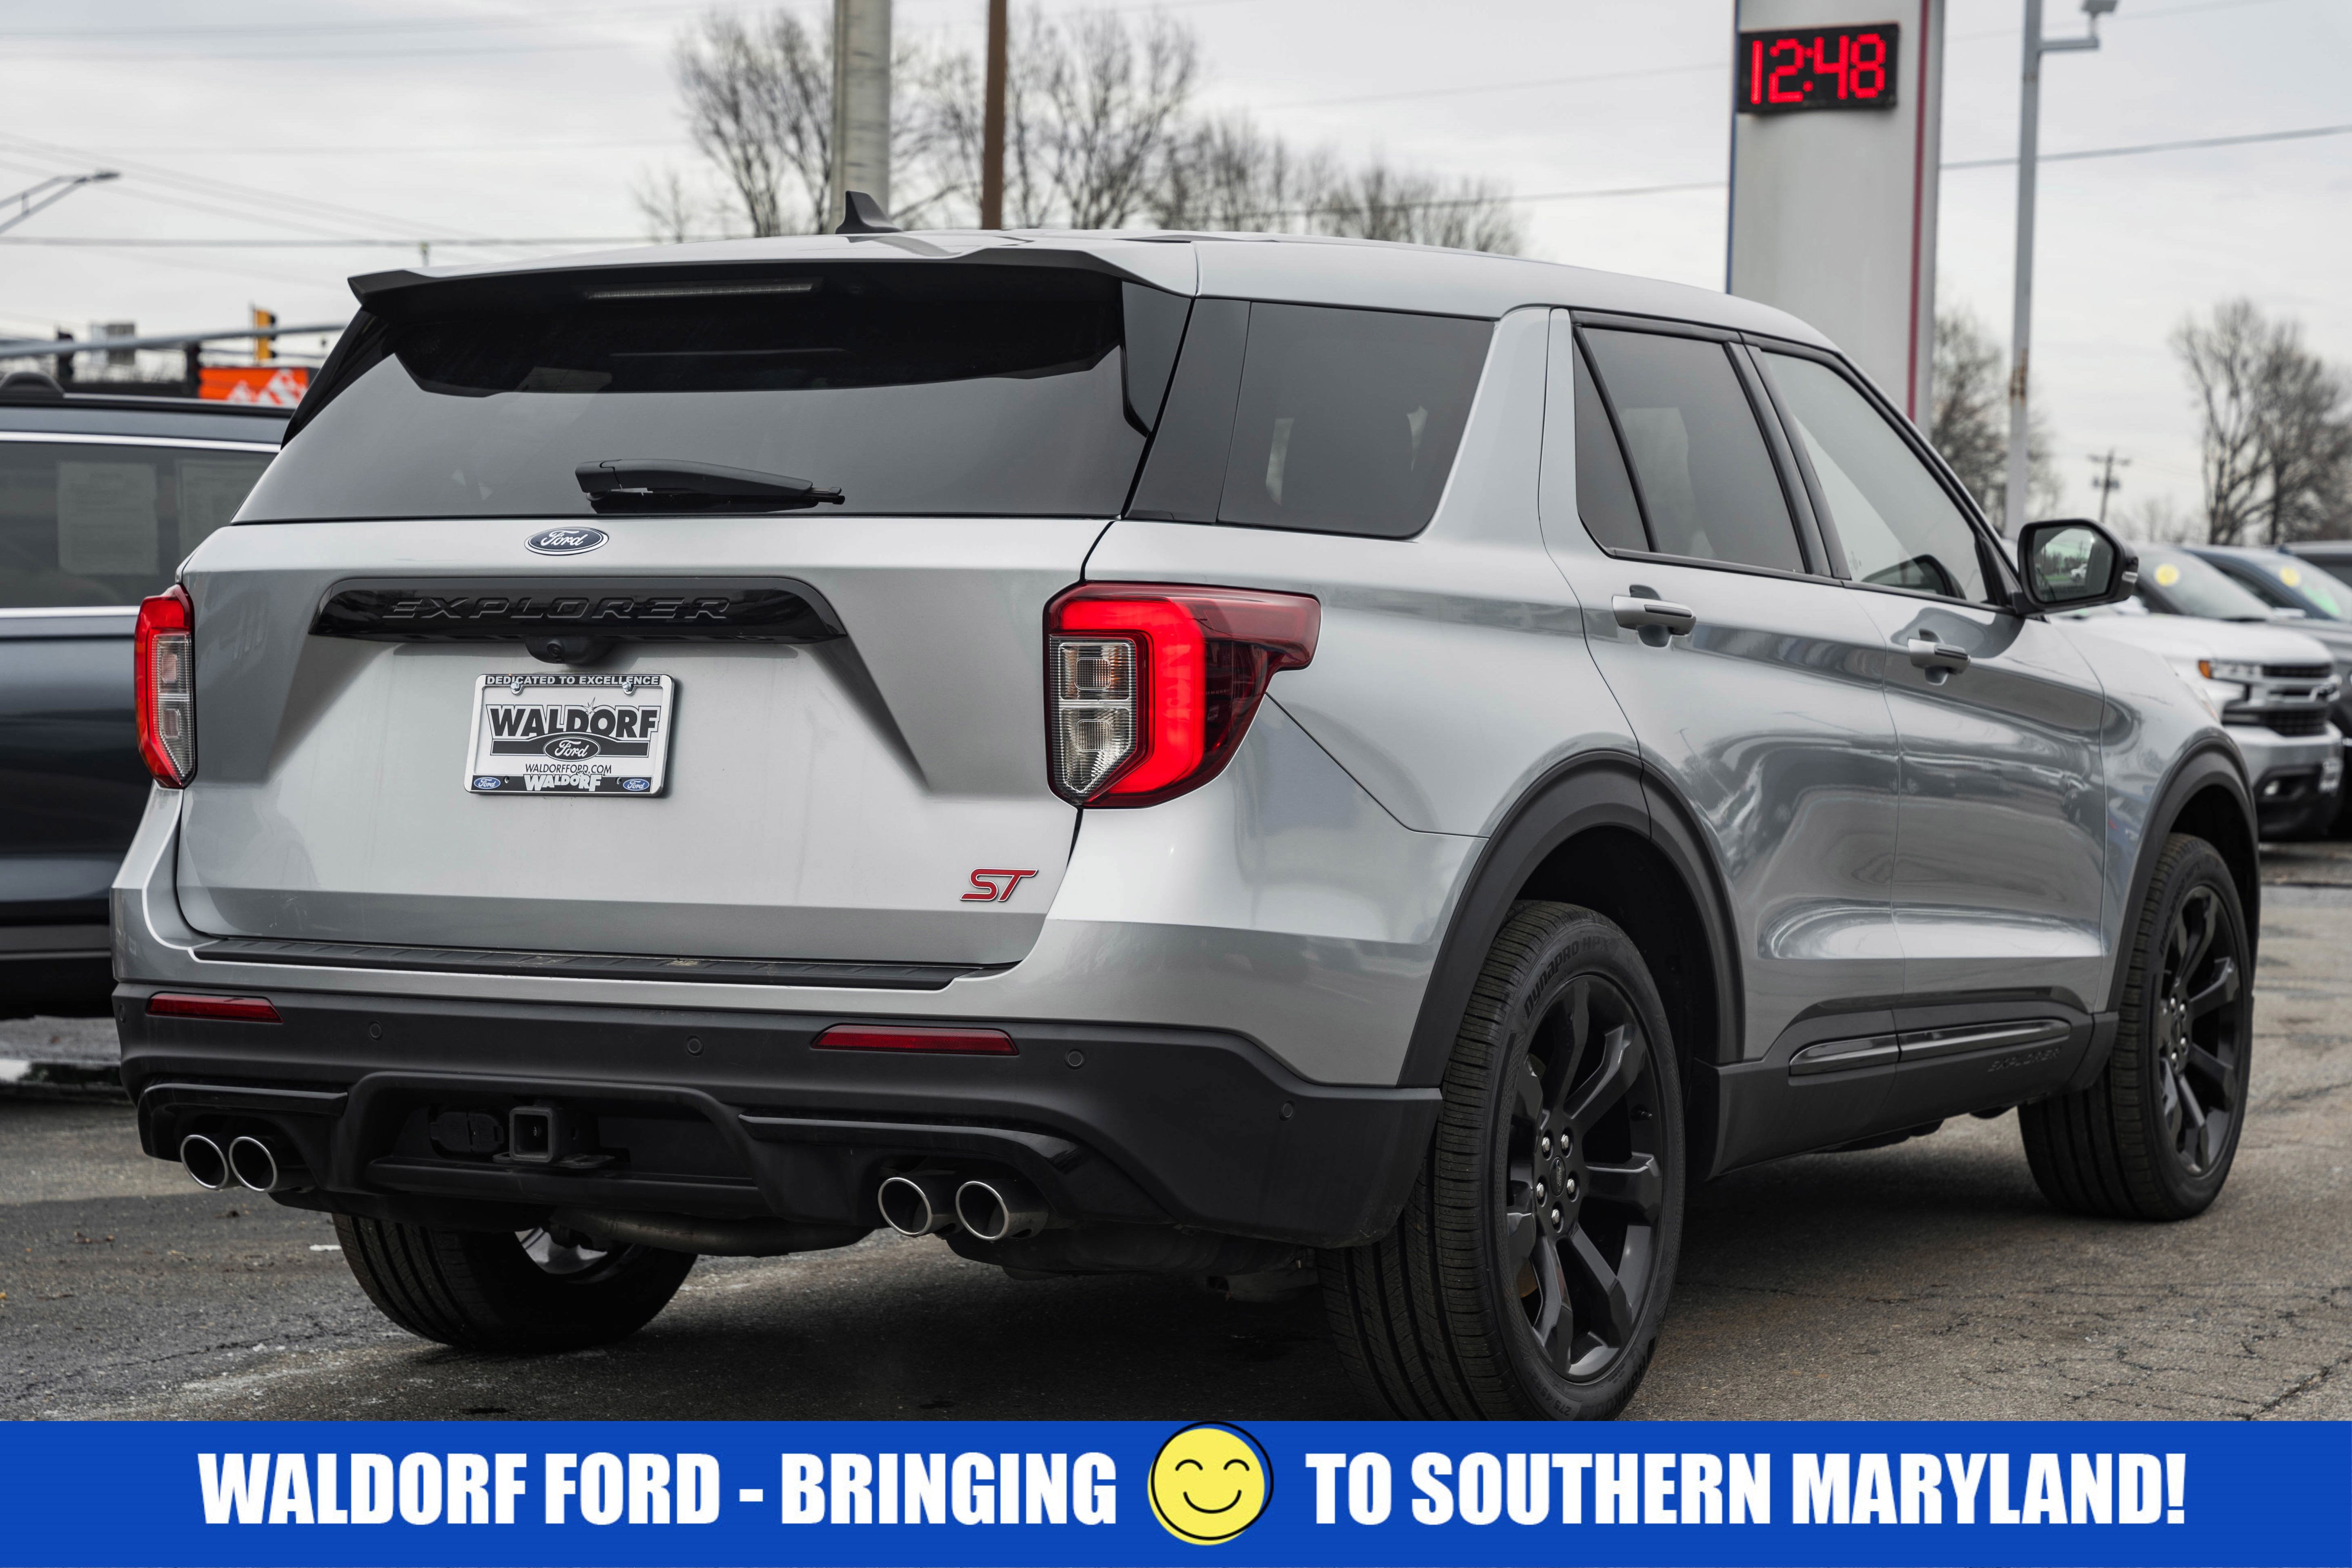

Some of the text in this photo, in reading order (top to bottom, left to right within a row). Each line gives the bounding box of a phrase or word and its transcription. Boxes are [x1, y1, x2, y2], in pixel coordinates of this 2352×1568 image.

[1751, 33, 1886, 105] 12:48
[540, 530, 588, 546] Ford
[382, 597, 731, 619] EXPLORER
[487, 676, 660, 685] DEDICATED TO EXCELLENCE
[486, 705, 660, 738] WALDORF
[554, 739, 589, 757] Ford
[526, 764, 612, 774] WALDORFFORD.COM
[479, 778, 497, 788] Ford
[523, 773, 602, 791] WALDORF
[627, 780, 646, 789] Ford
[960, 868, 1038, 901] ST
